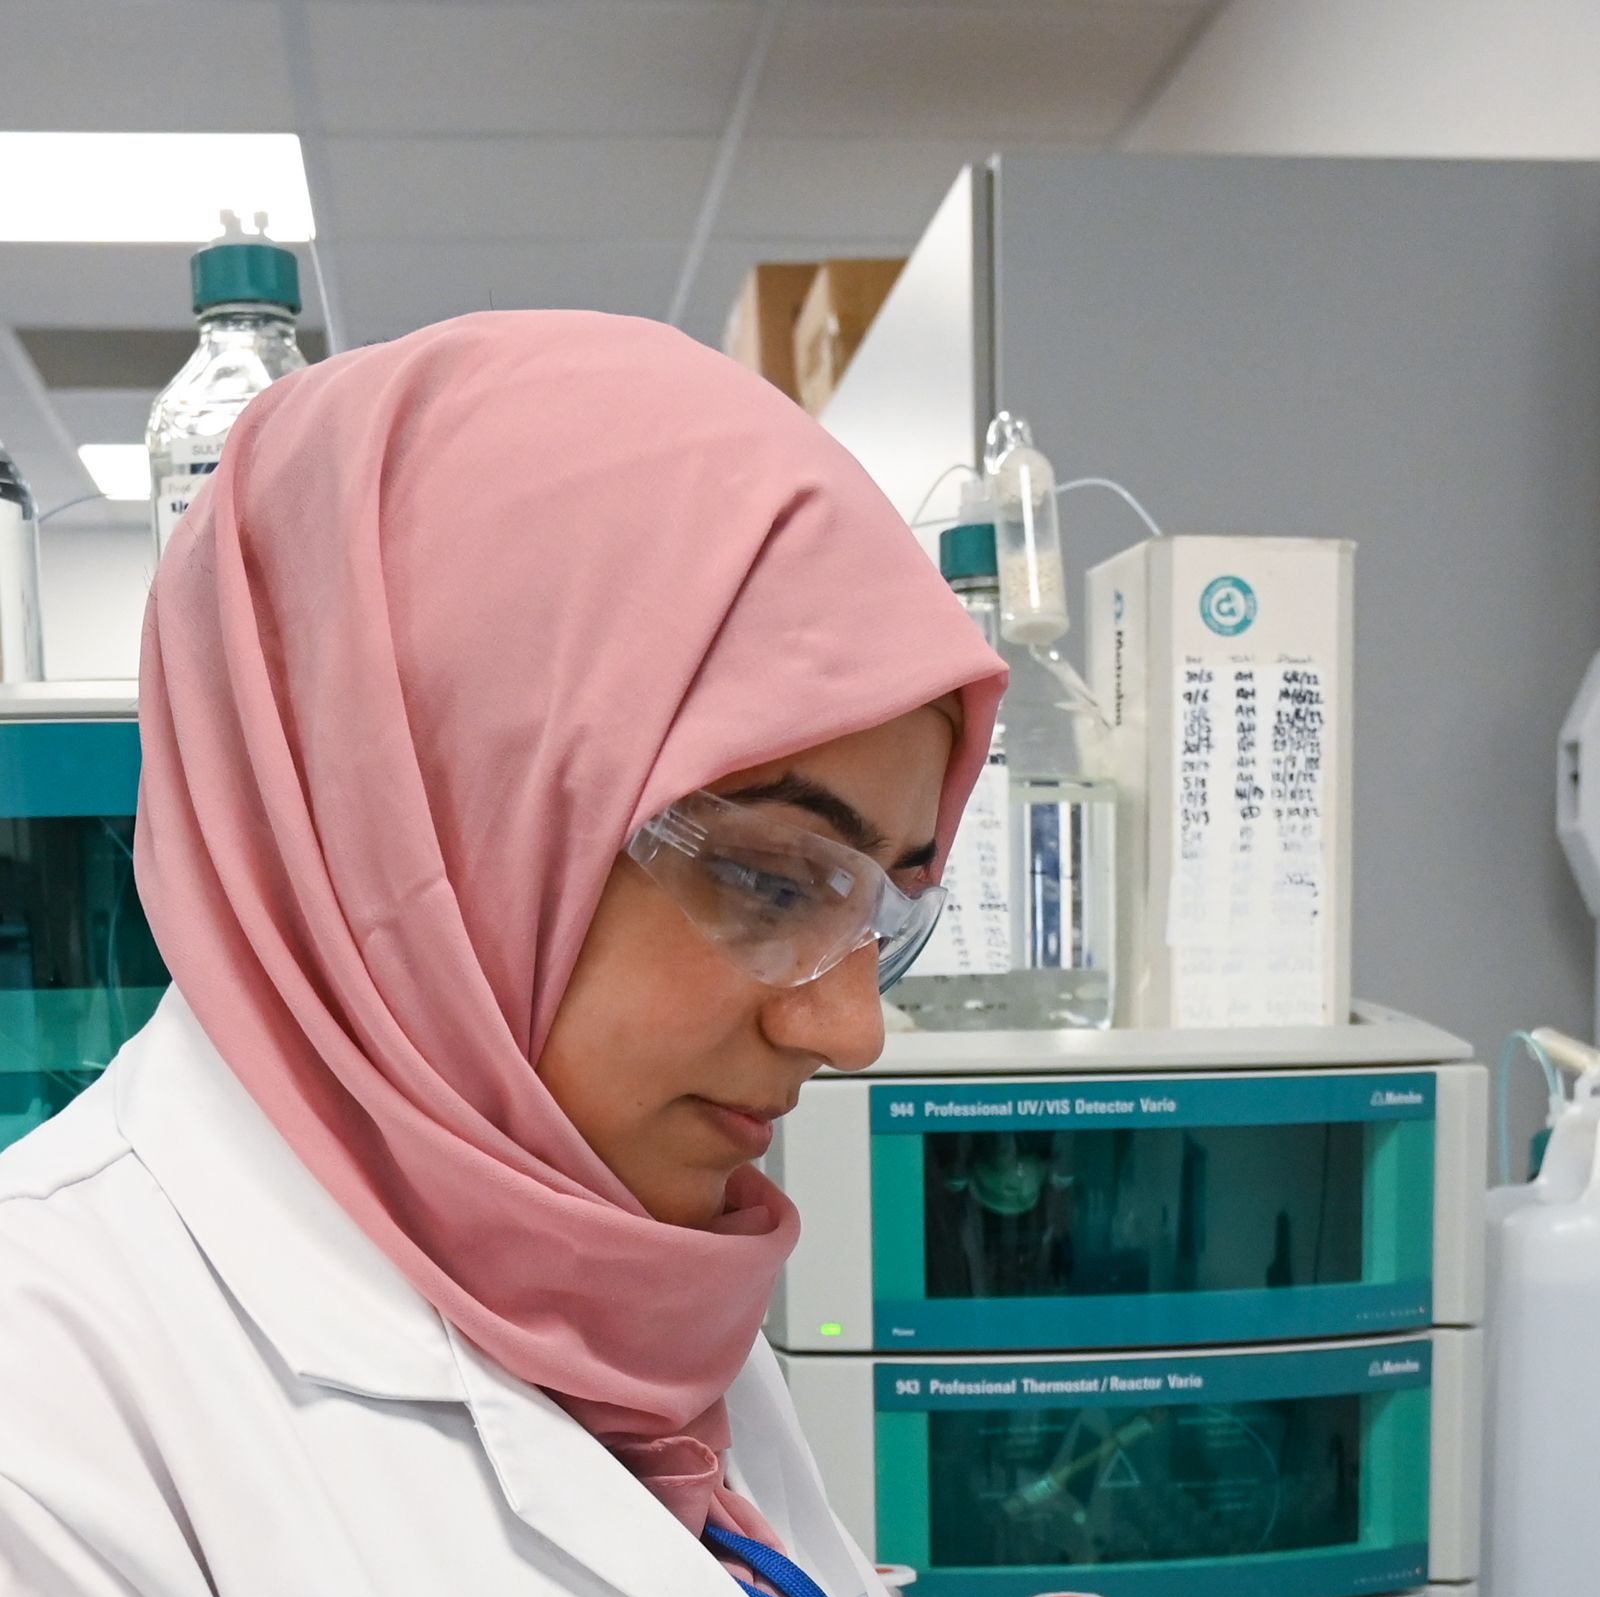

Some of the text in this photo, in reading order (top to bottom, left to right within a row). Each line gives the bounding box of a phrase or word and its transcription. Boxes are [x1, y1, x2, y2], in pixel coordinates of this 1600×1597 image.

[890, 1096, 1177, 1118] 944 Professional UV/VIS Detector Vario
[895, 1379, 920, 1396] 943
[929, 1378, 1017, 1396] Professional
[1167, 1372, 1203, 1390] Vario
